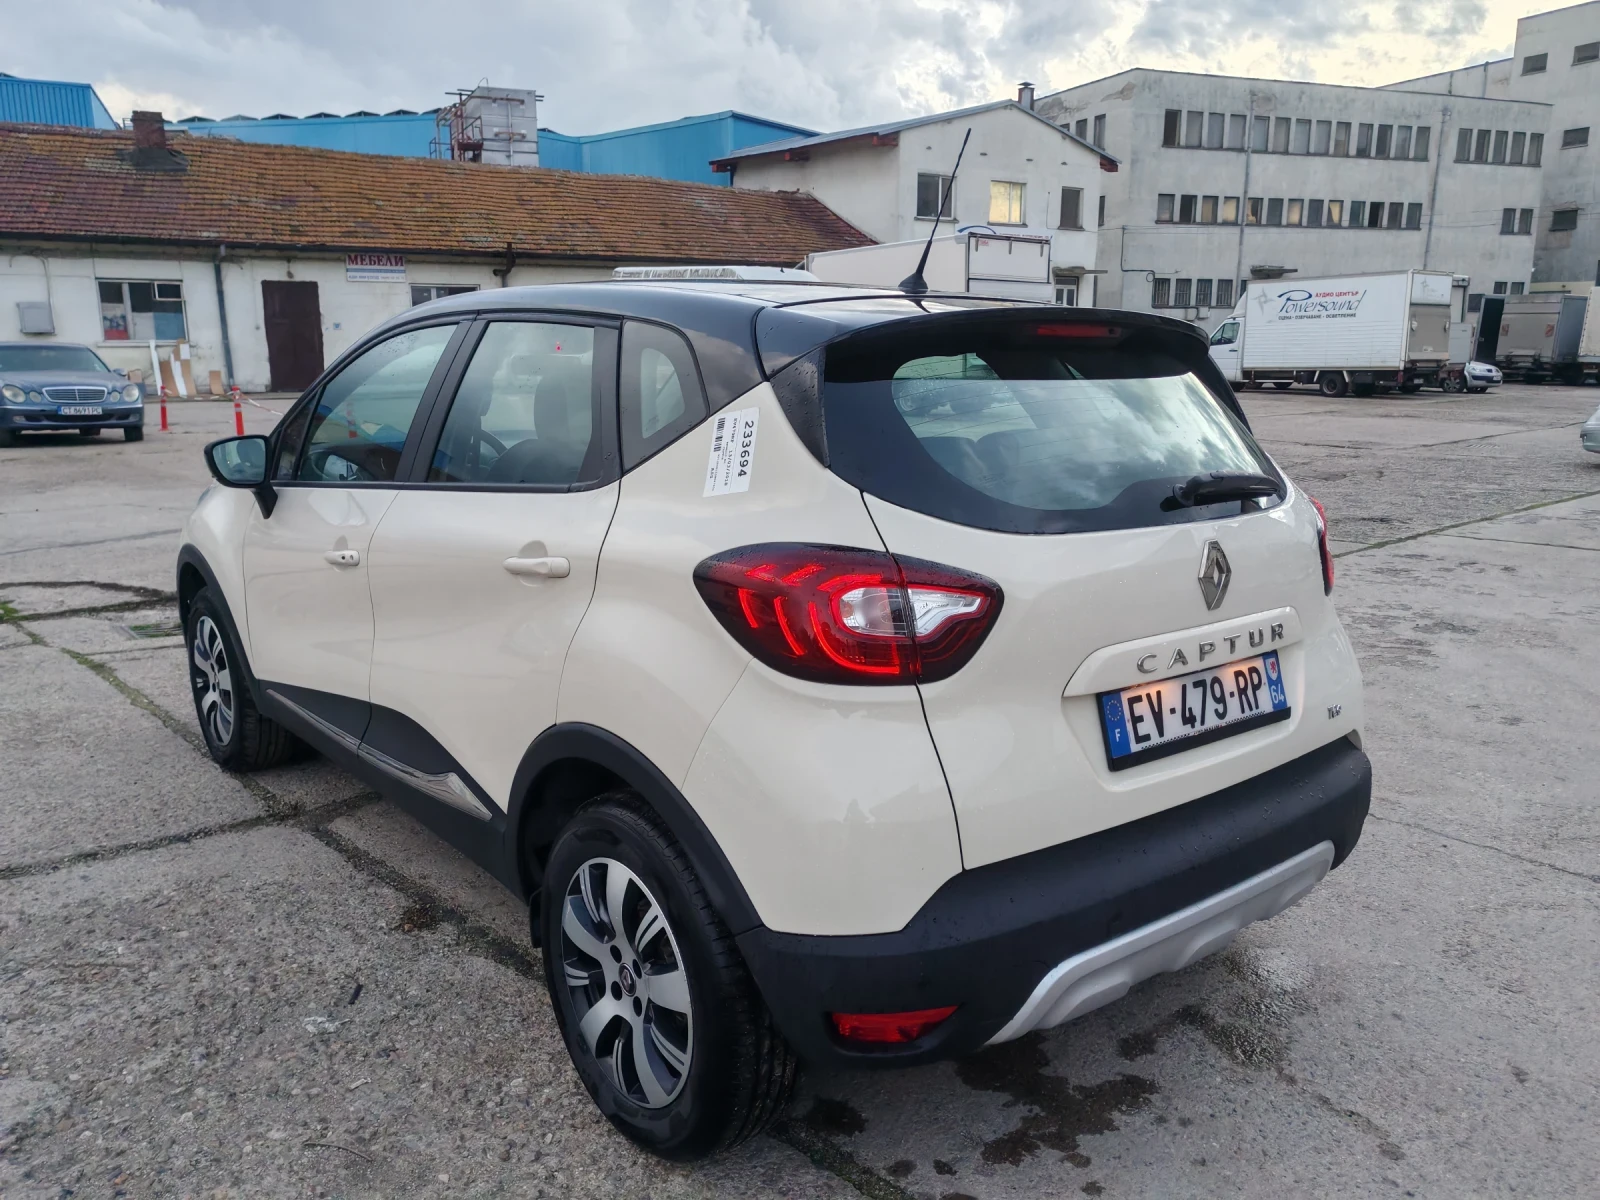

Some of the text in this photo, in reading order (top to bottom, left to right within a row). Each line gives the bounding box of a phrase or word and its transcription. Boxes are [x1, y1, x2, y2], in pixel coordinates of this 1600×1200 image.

[347, 254, 405, 267] МЕБЕЛИ
[1277, 289, 1367, 314] Powersound
[738, 420, 754, 477] 233694
[1137, 622, 1284, 673] CAPTUR
[1114, 729, 1121, 743] F
[1270, 684, 1286, 704] 64
